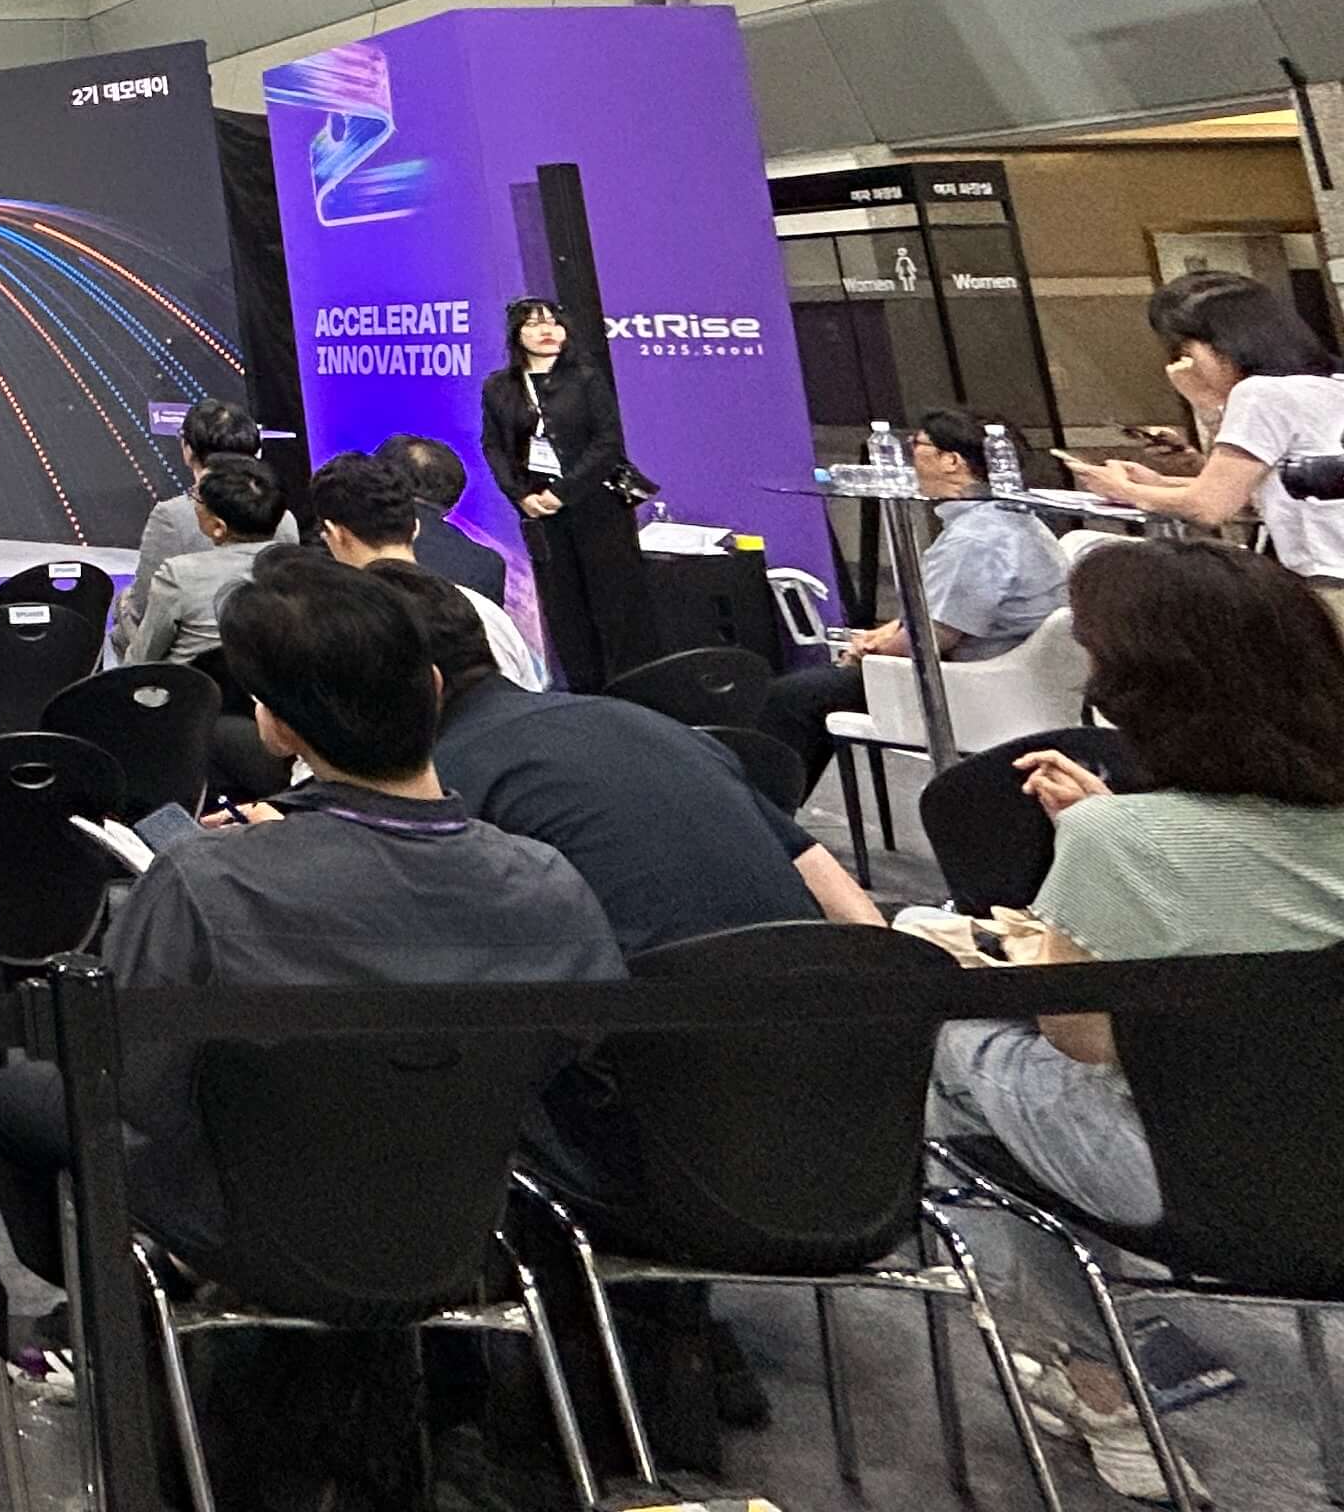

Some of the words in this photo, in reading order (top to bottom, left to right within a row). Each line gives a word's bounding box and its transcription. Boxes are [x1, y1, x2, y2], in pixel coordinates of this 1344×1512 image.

[71, 85, 99, 106] 2기
[103, 75, 169, 102] 데모데이
[842, 277, 896, 292] Women
[951, 273, 1018, 290] Women
[315, 300, 470, 338] ACCELERATE
[603, 313, 761, 339] xtRise
[316, 343, 472, 376] INNOVATION
[639, 343, 764, 356] 2025.Seoul
